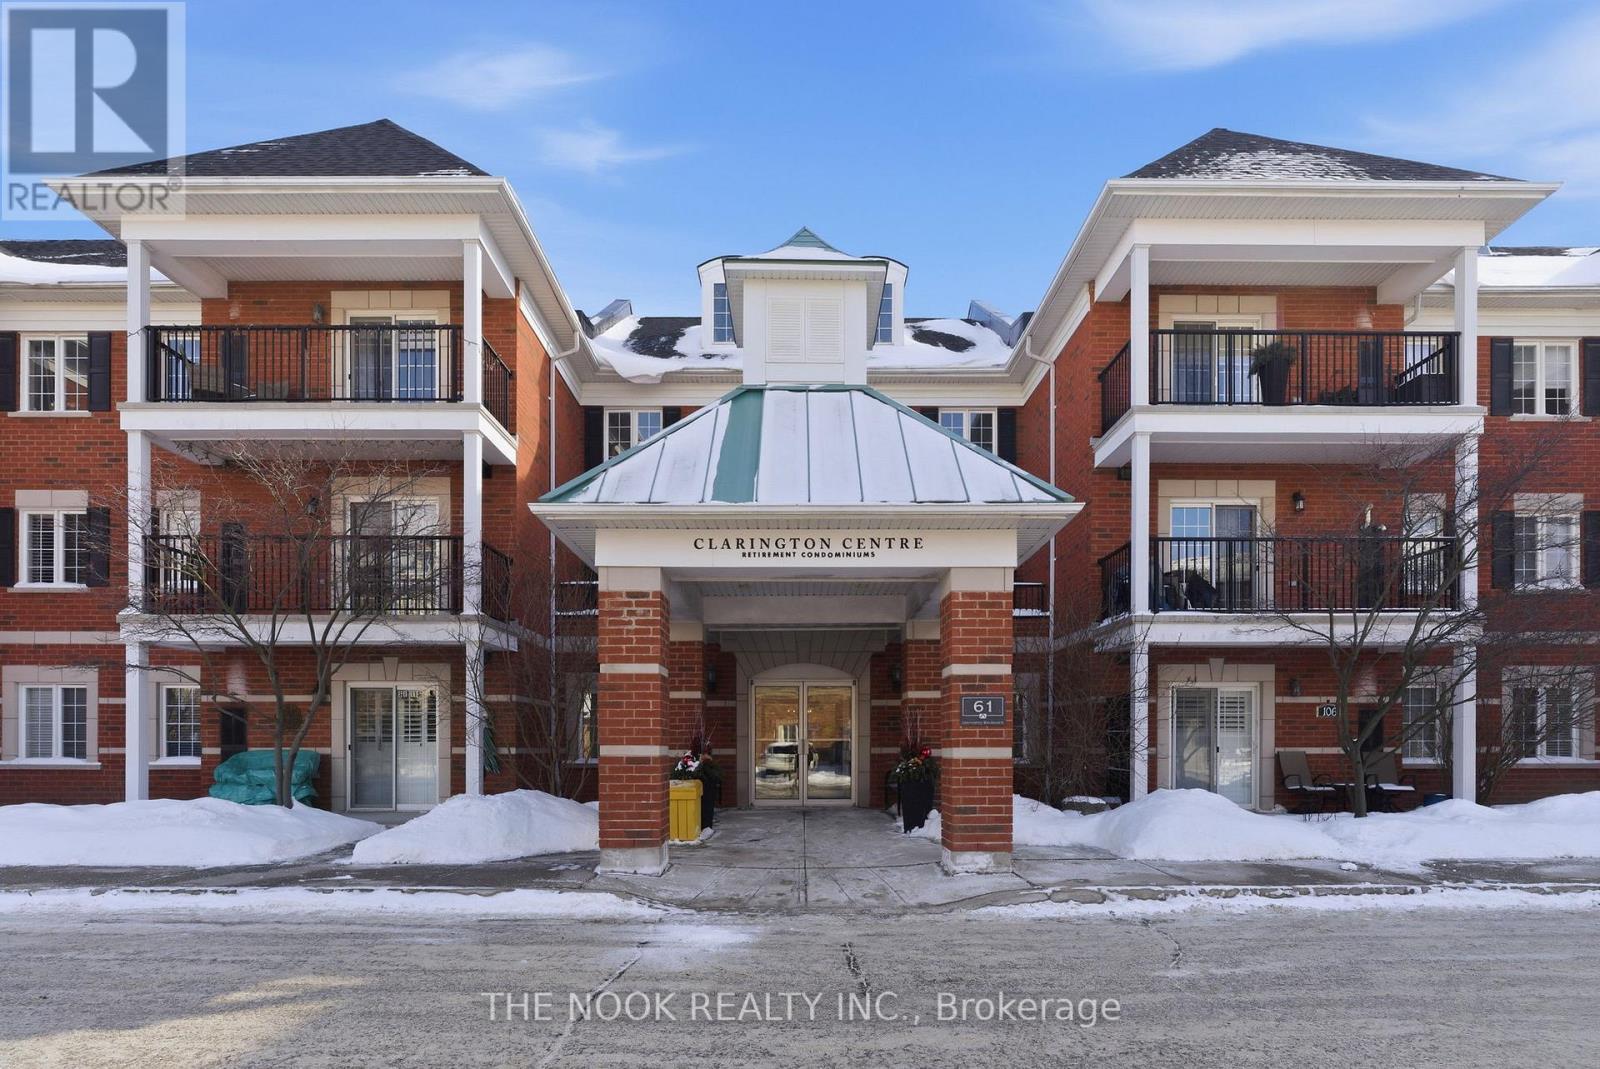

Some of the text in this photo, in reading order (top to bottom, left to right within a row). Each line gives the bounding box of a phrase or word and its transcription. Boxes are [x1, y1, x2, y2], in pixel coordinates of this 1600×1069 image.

[693, 537, 924, 550] CLARINGTON CENTRE
[742, 551, 876, 559] RETIREMENT CONDOMINIUMS
[973, 700, 993, 713] 61
